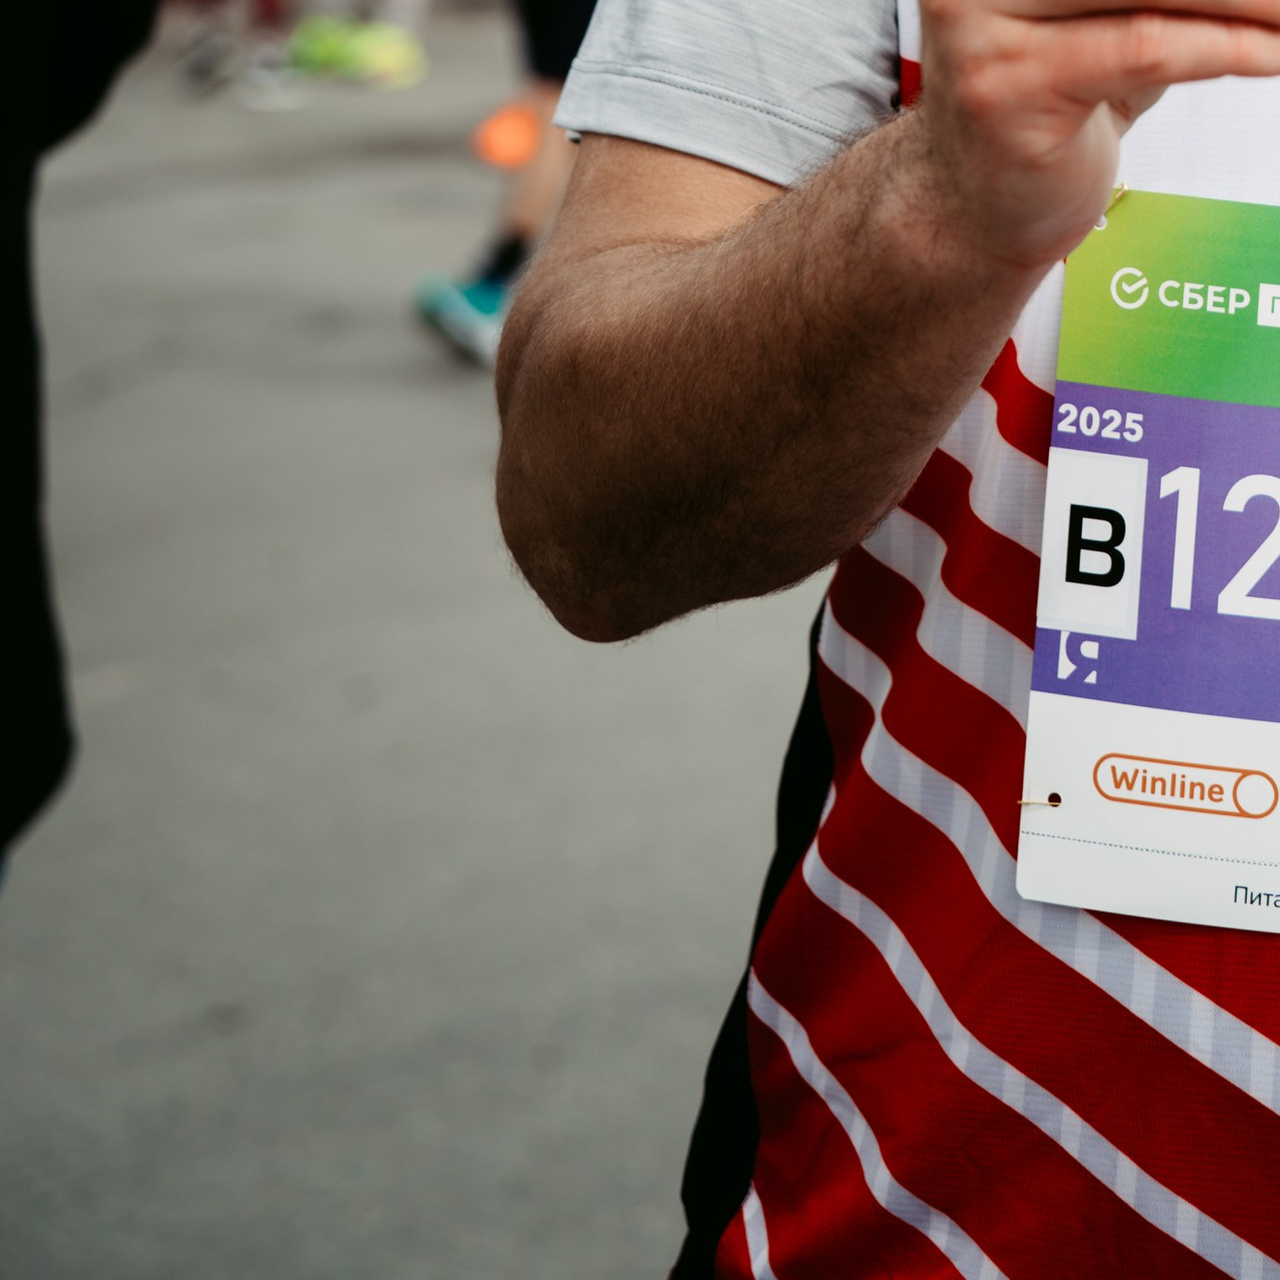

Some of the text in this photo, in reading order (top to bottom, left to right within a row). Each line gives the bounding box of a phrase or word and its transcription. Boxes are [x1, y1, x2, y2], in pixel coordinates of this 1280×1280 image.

[1158, 279, 1251, 315] СБЕР
[1057, 403, 1144, 442] 2025
[1110, 765, 1225, 803] Winline
